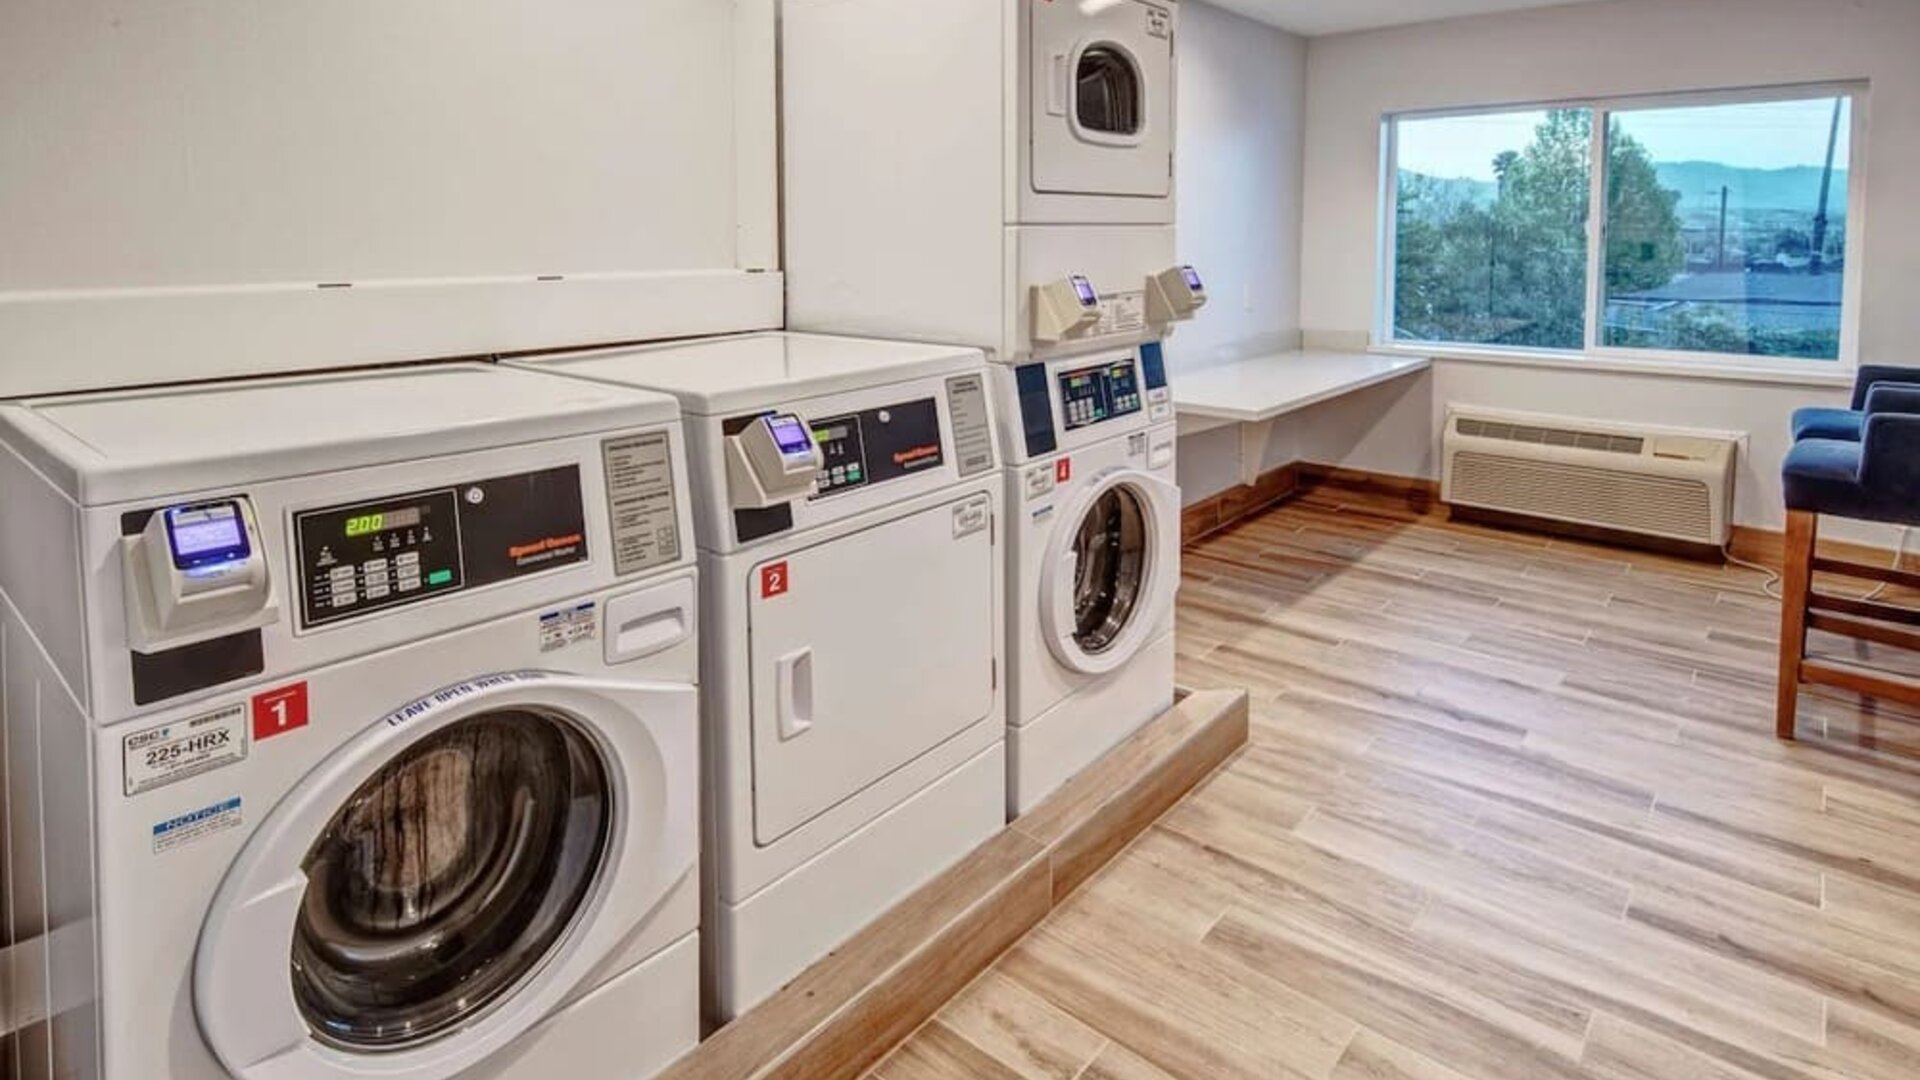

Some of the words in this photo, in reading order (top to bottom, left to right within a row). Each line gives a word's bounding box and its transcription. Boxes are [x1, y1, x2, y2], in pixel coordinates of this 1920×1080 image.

[769, 573, 780, 592] 2
[271, 700, 287, 726] 1
[387, 700, 431, 727] LEAVE
[434, 684, 473, 703] OPEN
[146, 729, 230, 765] 225-HRX
